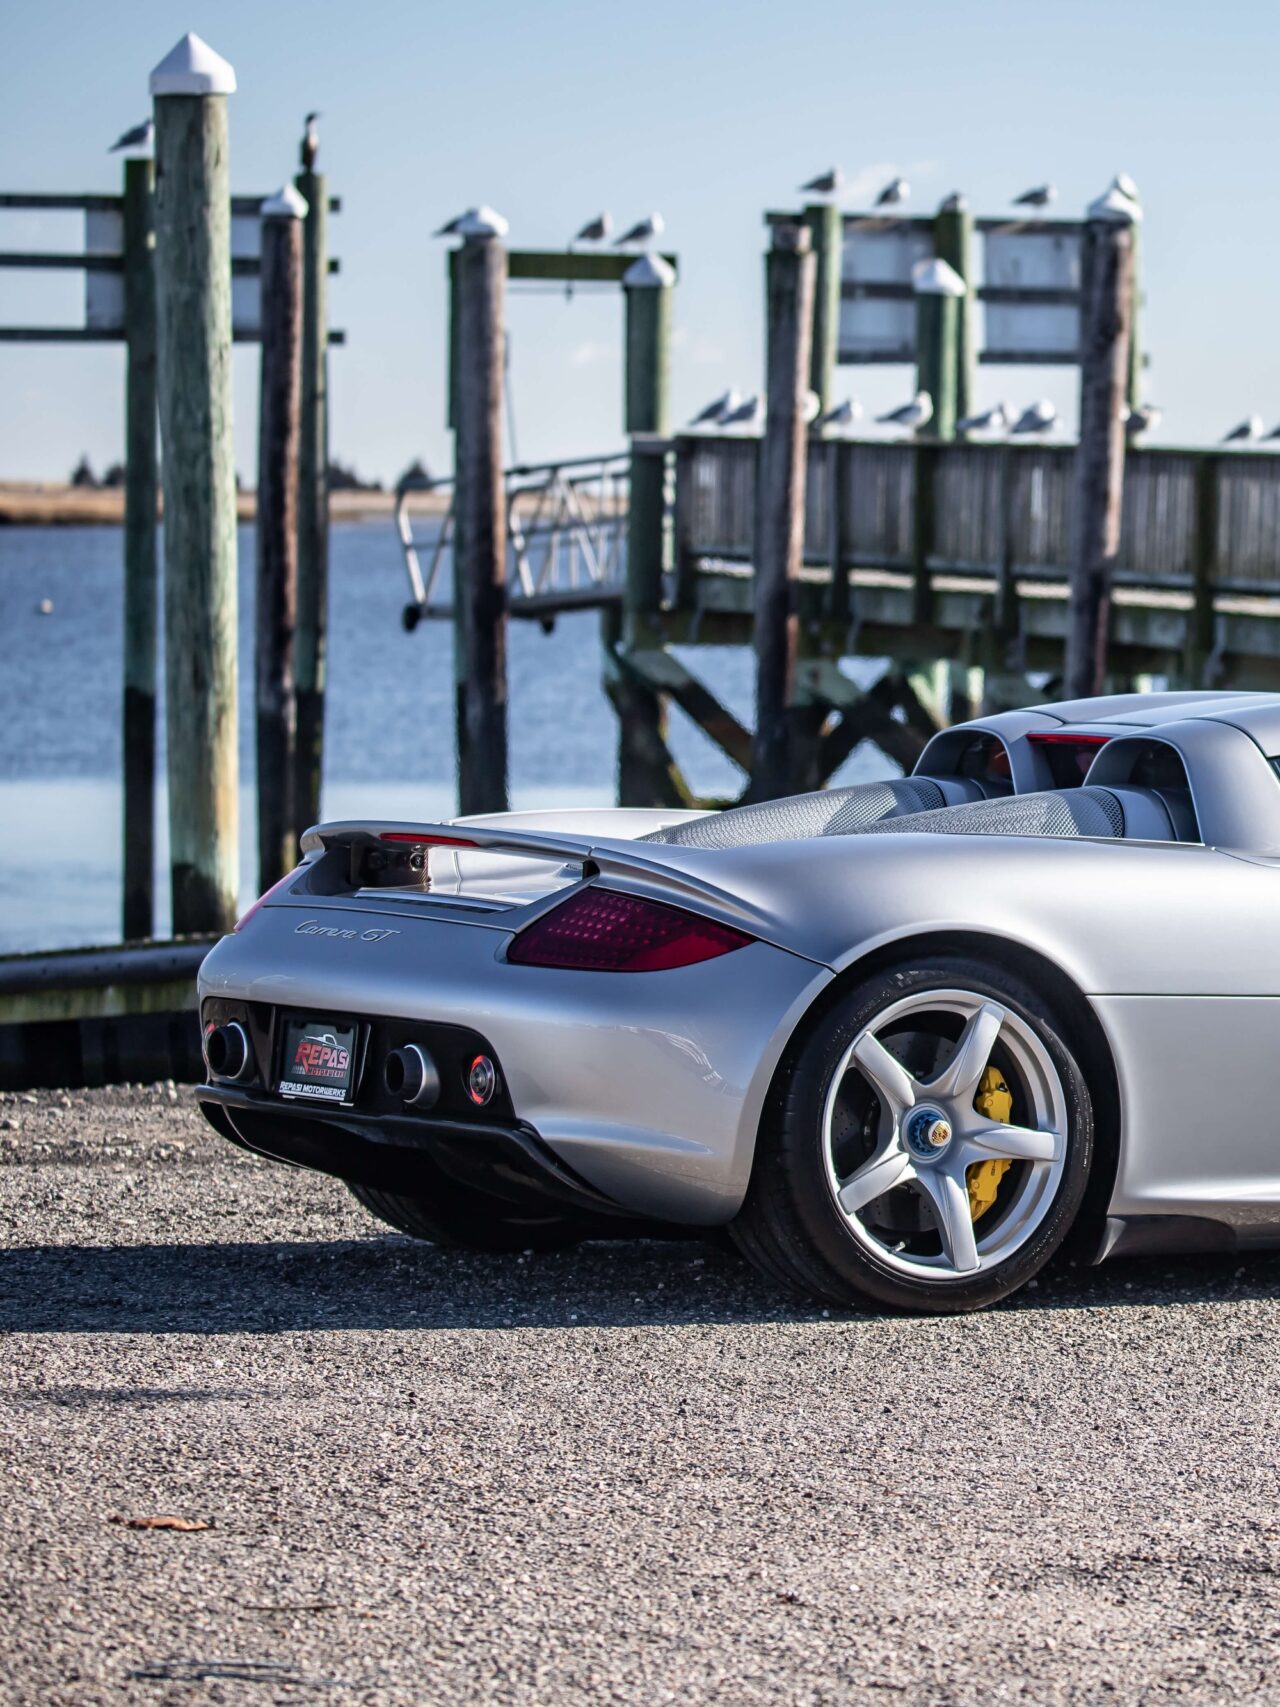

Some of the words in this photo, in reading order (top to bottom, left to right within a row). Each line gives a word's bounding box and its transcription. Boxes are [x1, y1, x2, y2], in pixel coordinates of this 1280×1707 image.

[294, 919, 357, 939] Carrera
[360, 928, 401, 942] GT
[294, 1041, 350, 1073] REPASI
[279, 1081, 303, 1092] REPASI
[302, 1084, 347, 1098] MOTORWERKS
